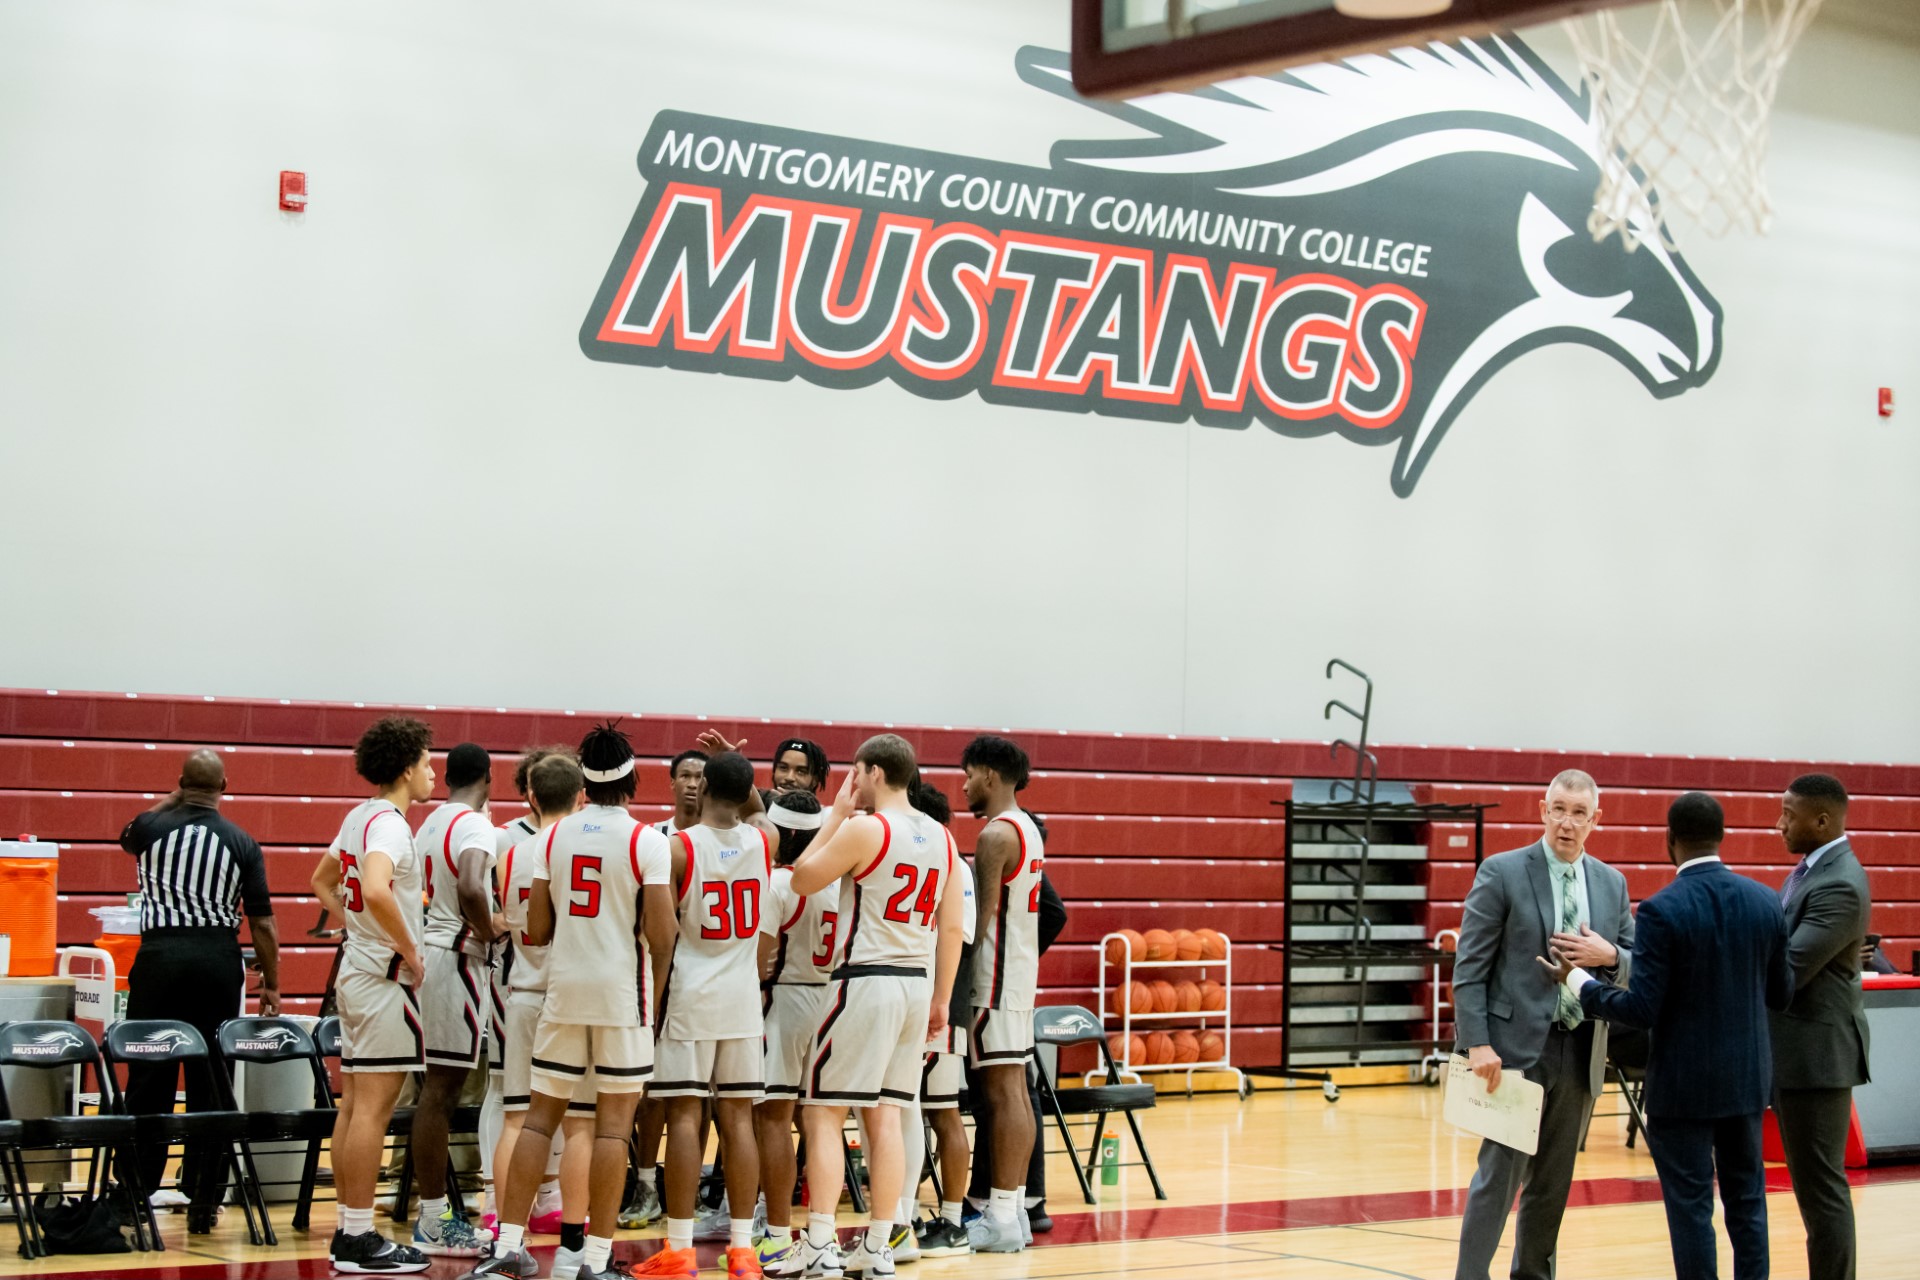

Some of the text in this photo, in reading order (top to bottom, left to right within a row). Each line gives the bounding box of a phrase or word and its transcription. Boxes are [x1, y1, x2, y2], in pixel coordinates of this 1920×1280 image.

[653, 129, 1432, 278] MONTGOMERY COUNTY COMMUNITY COLLEGE
[598, 182, 1428, 429] MUSTANGS
[569, 854, 603, 918] 5
[883, 862, 940, 927] 24
[701, 878, 761, 940] 30
[75, 991, 100, 1004] TORADE
[125, 1043, 170, 1053] MUSTANGS
[235, 1041, 279, 1050] MUSTANGS
[1043, 1027, 1077, 1035] MUSTANGS
[12, 1045, 60, 1055] MUSTANGS
